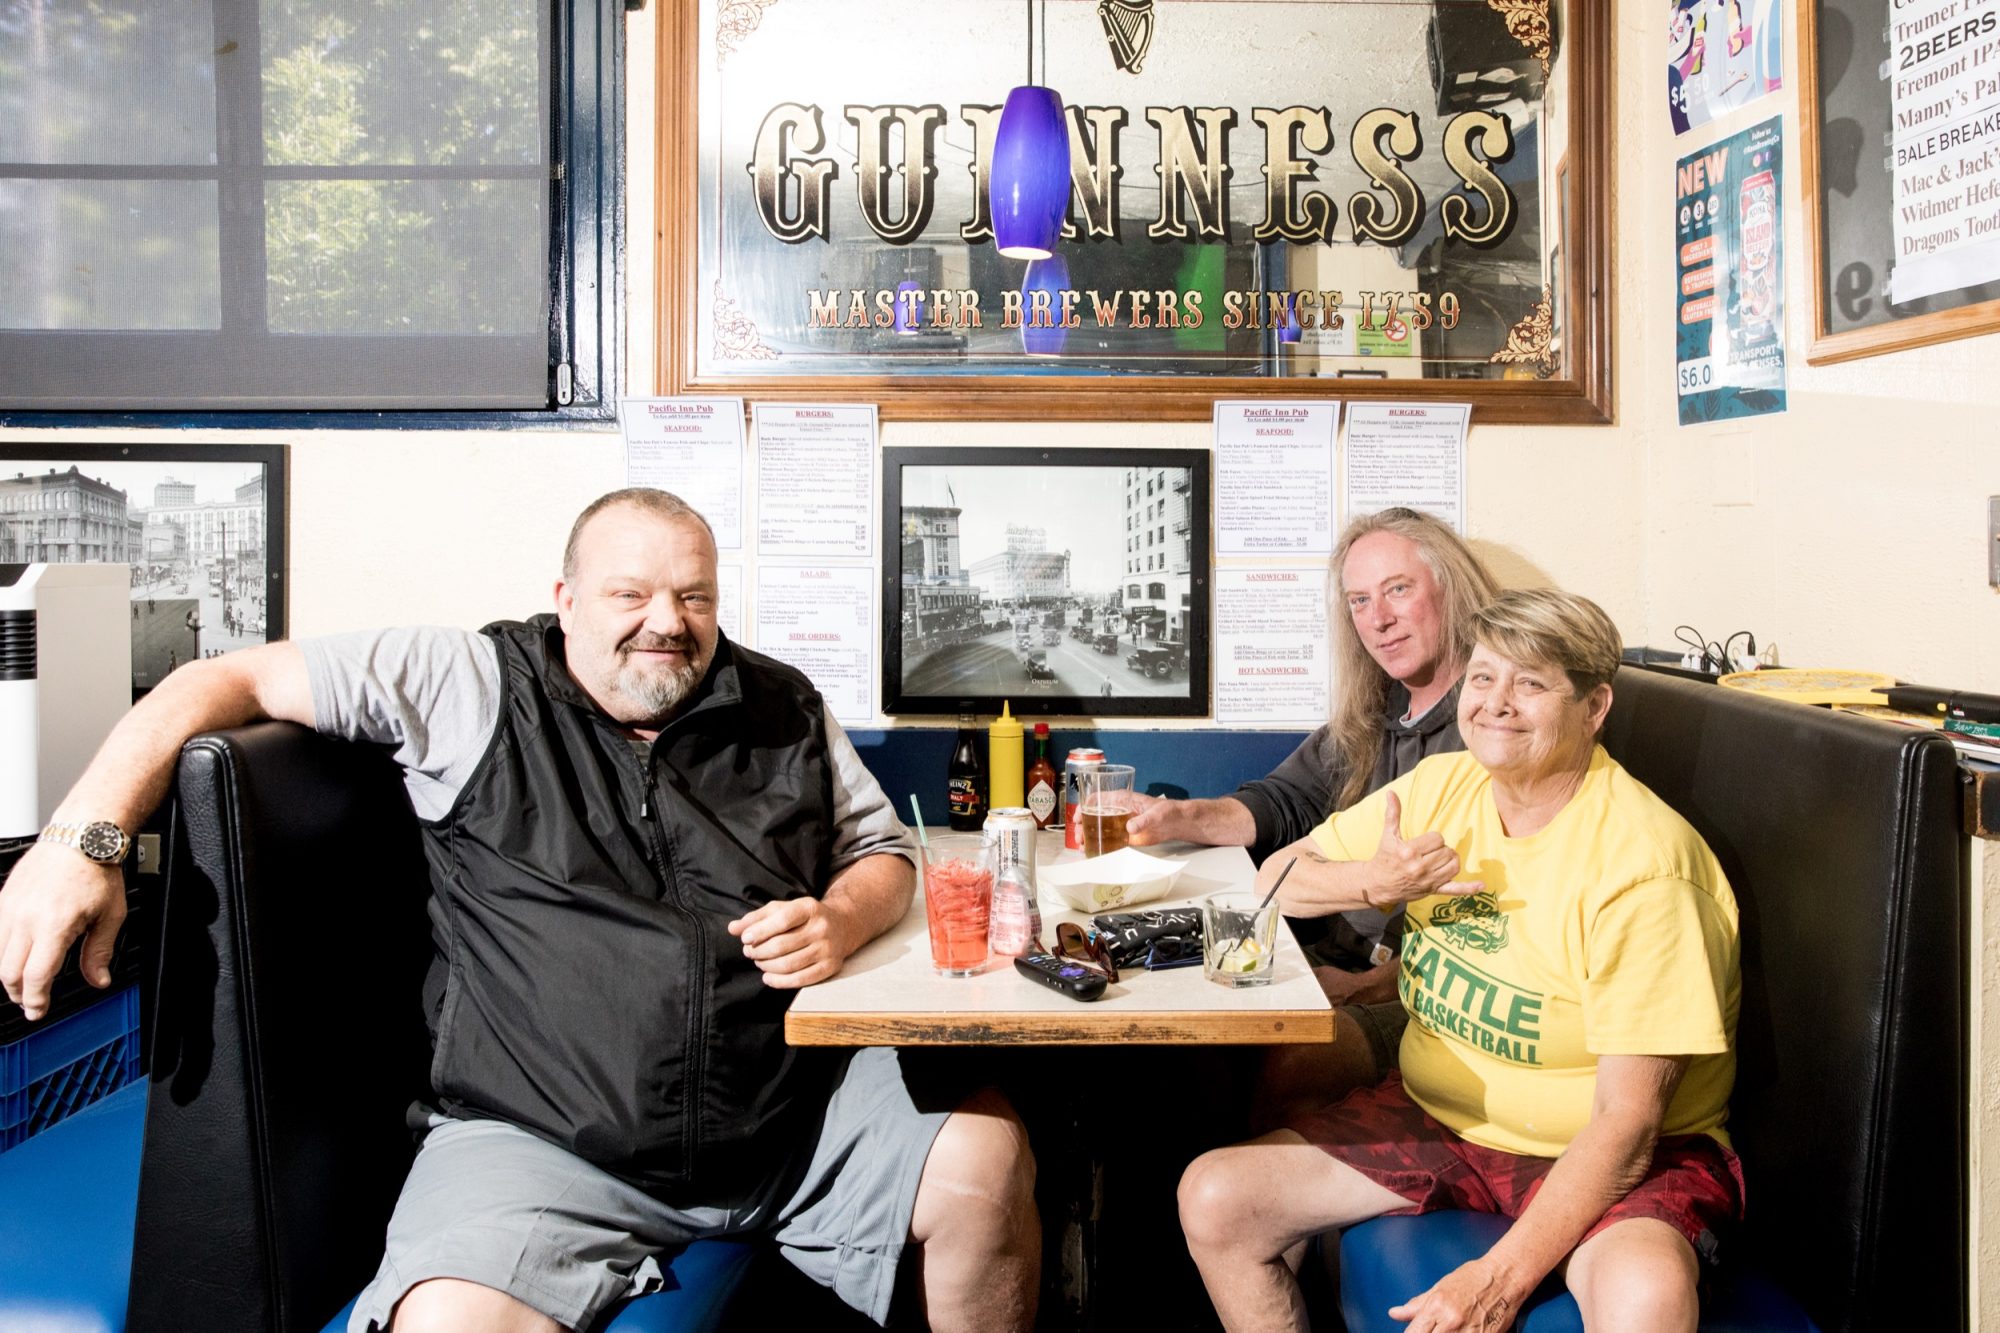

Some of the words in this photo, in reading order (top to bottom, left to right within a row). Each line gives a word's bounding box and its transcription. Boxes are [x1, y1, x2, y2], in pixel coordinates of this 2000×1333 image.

[1894, 2, 1958, 43] Trumer
[1899, 11, 1997, 71] 2BEERS
[1896, 55, 1967, 101] Fremont
[1897, 138, 1936, 167] BALE
[746, 101, 1519, 250] GUINNESS
[1678, 147, 1729, 200] NEW
[1901, 175, 1933, 198] Mac
[1936, 164, 1952, 185] &
[1901, 195, 1962, 225] Widmer
[1903, 226, 1960, 256] Dragons
[807, 289, 983, 329] MASTER
[1000, 289, 1205, 330] BREWERS
[1223, 289, 1344, 331] SINCE
[1358, 291, 1461, 331] 1759
[648, 405, 677, 413] Pacific
[679, 405, 694, 413] Inn
[696, 405, 713, 413] Pub
[795, 410, 834, 418] BURGERS:
[1243, 408, 1272, 417] Pacific
[1275, 408, 1289, 417] Inn
[1292, 408, 1309, 417] Pub
[664, 425, 703, 433] SEAFOOD:
[1256, 428, 1294, 436] SEAFOOD:
[1246, 573, 1299, 581] SANDWICHES:
[789, 632, 806, 641] SIDE
[807, 632, 841, 641] ORDERS:
[1238, 667, 1254, 675] HOT
[1256, 667, 1309, 675] SANDWICHES:
[1413, 988, 1543, 1066] BASKETBALL
